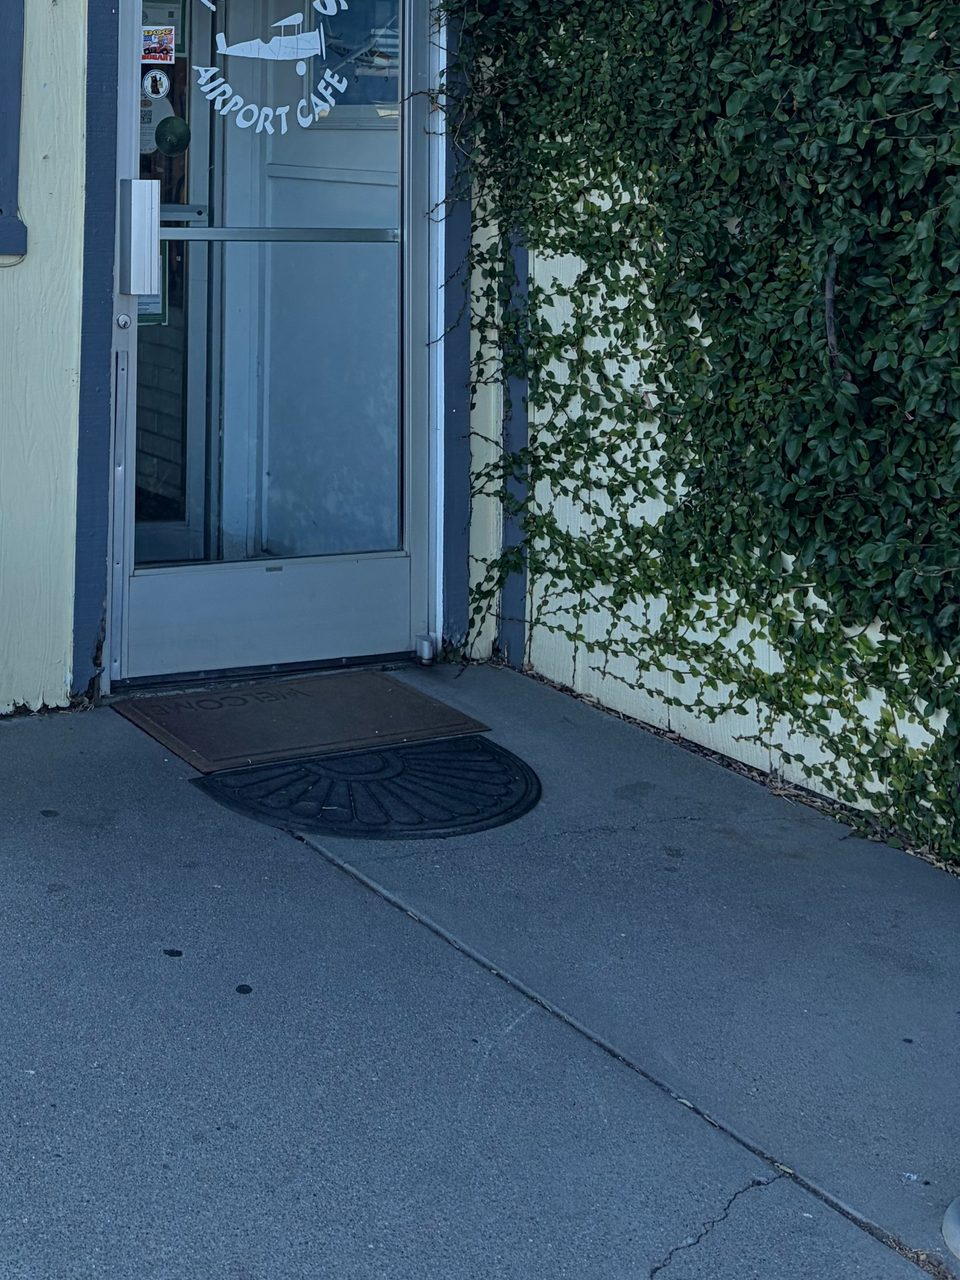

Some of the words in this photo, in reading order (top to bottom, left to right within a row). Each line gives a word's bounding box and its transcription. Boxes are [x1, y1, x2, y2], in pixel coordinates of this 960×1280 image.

[192, 65, 290, 135] AIRPORT
[296, 68, 349, 128] CAFE
[150, 687, 312, 717] WELCOME
